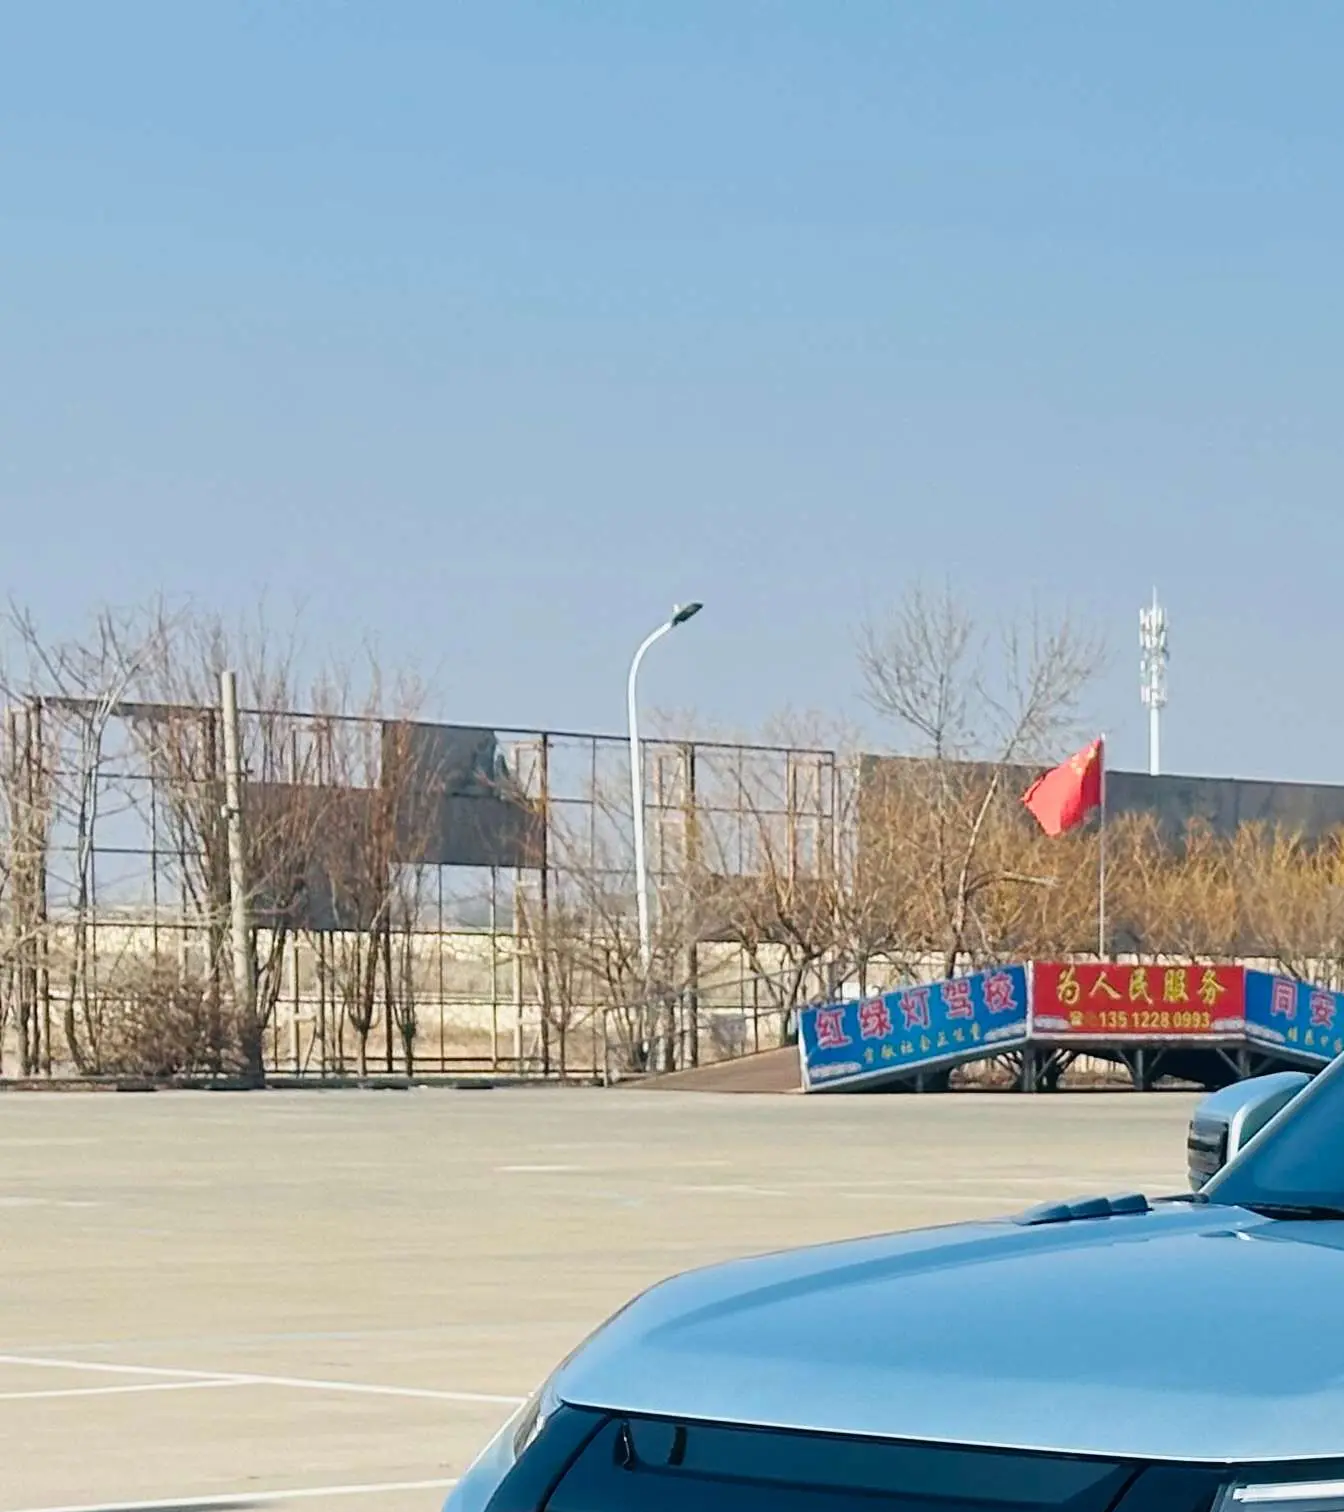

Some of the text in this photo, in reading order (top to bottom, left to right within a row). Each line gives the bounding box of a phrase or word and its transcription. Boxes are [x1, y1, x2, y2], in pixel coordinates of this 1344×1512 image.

[1055, 964, 1227, 1005] 为人民服务
[815, 971, 1018, 1049] 红绿灯驾校
[1099, 1011, 1128, 1027] 135
[1132, 1011, 1170, 1027] 1228
